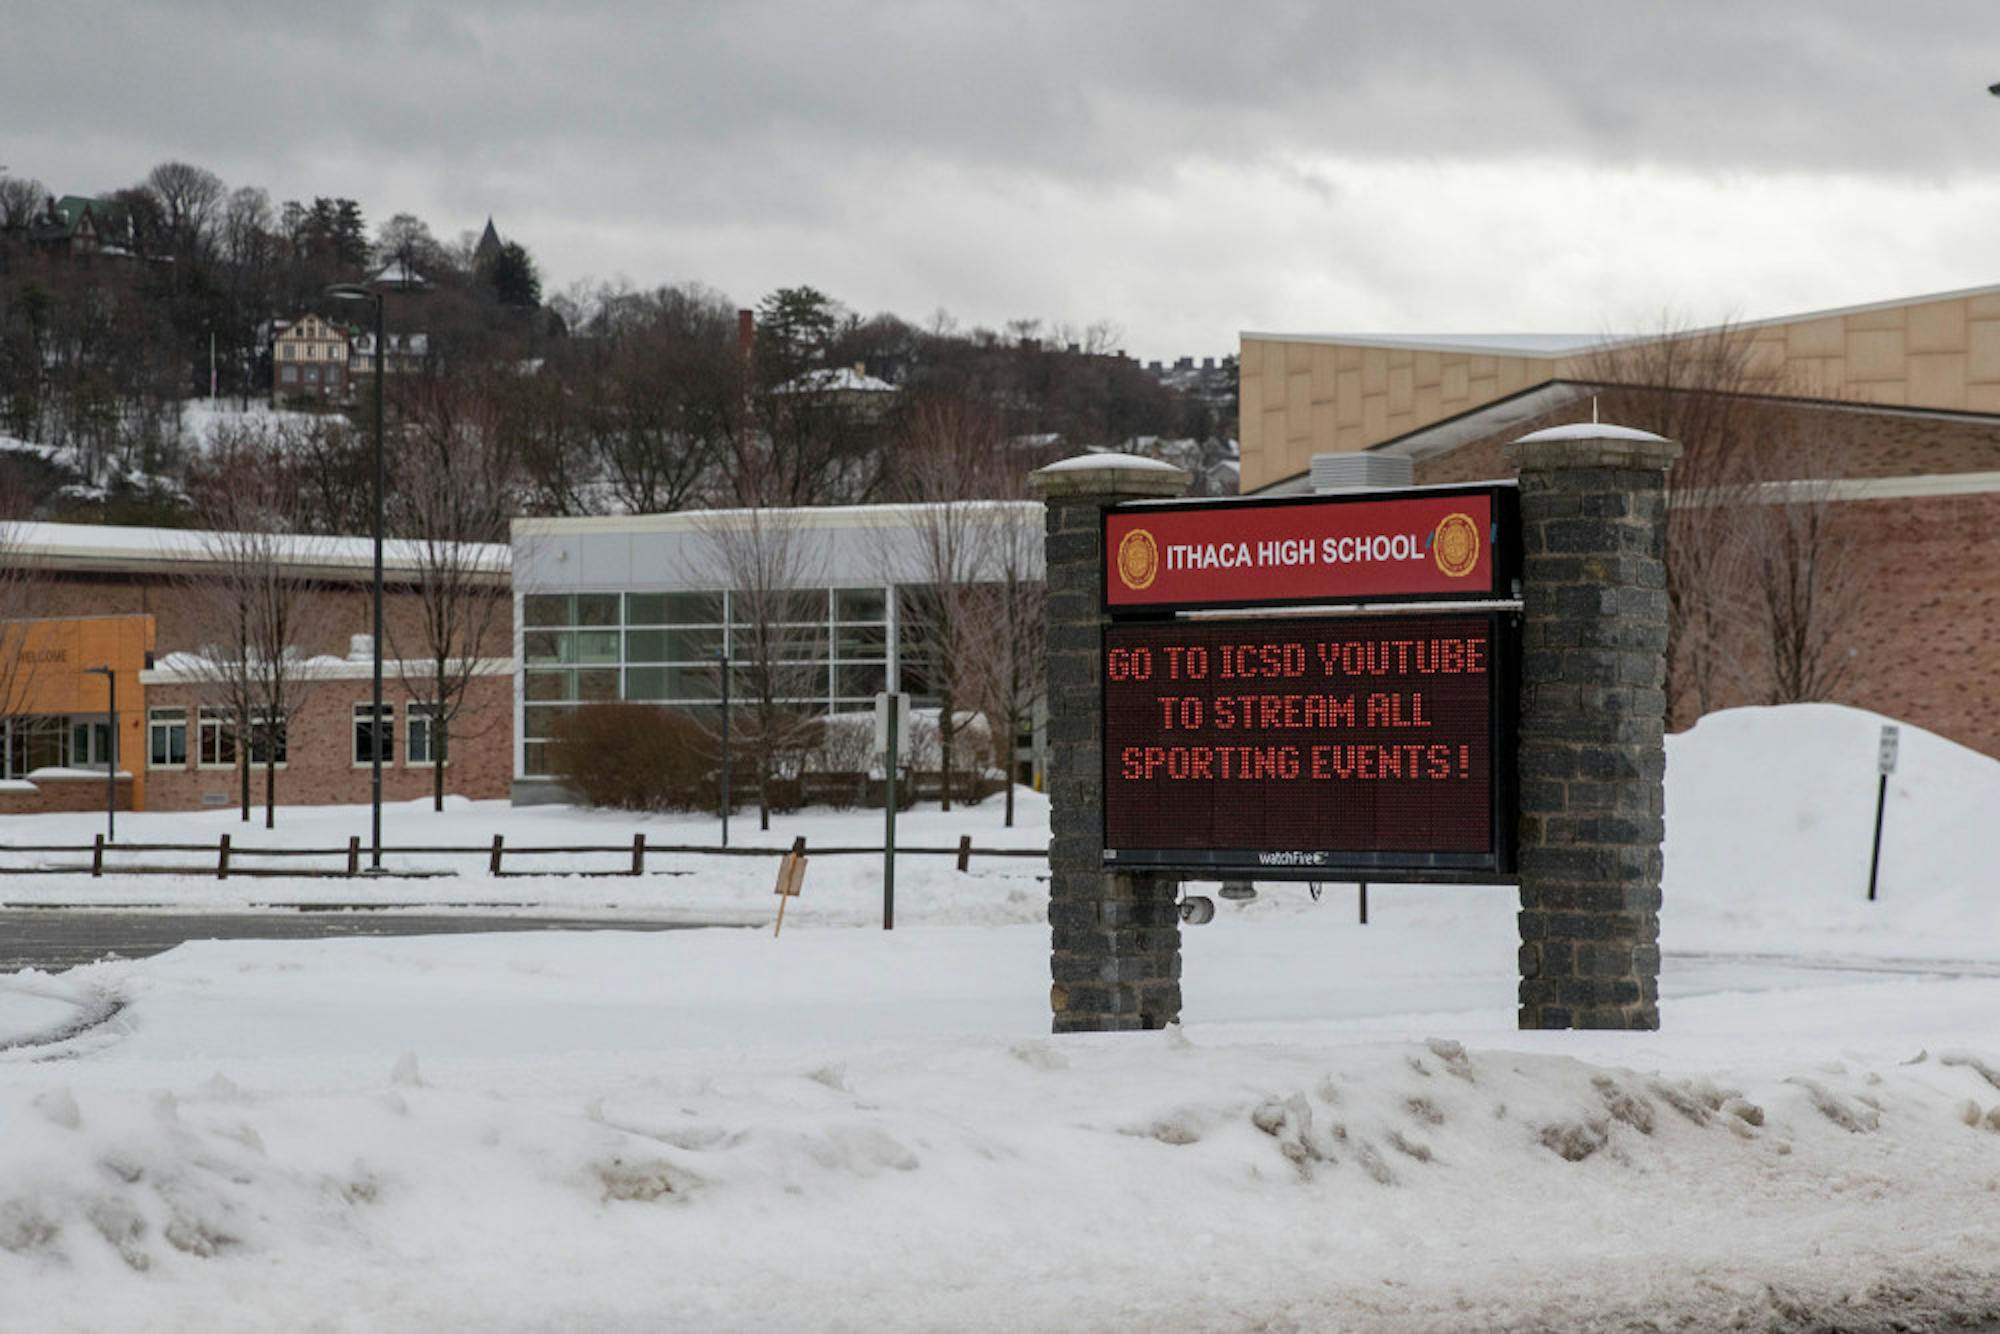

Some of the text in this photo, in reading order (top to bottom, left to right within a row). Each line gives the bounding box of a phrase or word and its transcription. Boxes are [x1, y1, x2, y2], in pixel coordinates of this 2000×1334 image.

[1166, 541, 1253, 570] ITHACA
[1258, 538, 1315, 566] HIGH
[1322, 534, 1425, 563] SCHOOL
[1108, 639, 1487, 681] GO TO ICSD YOUTUBE
[1157, 693, 1432, 729] TO STREAM ALL
[1121, 744, 1470, 779] SPORTING EVENTS!
